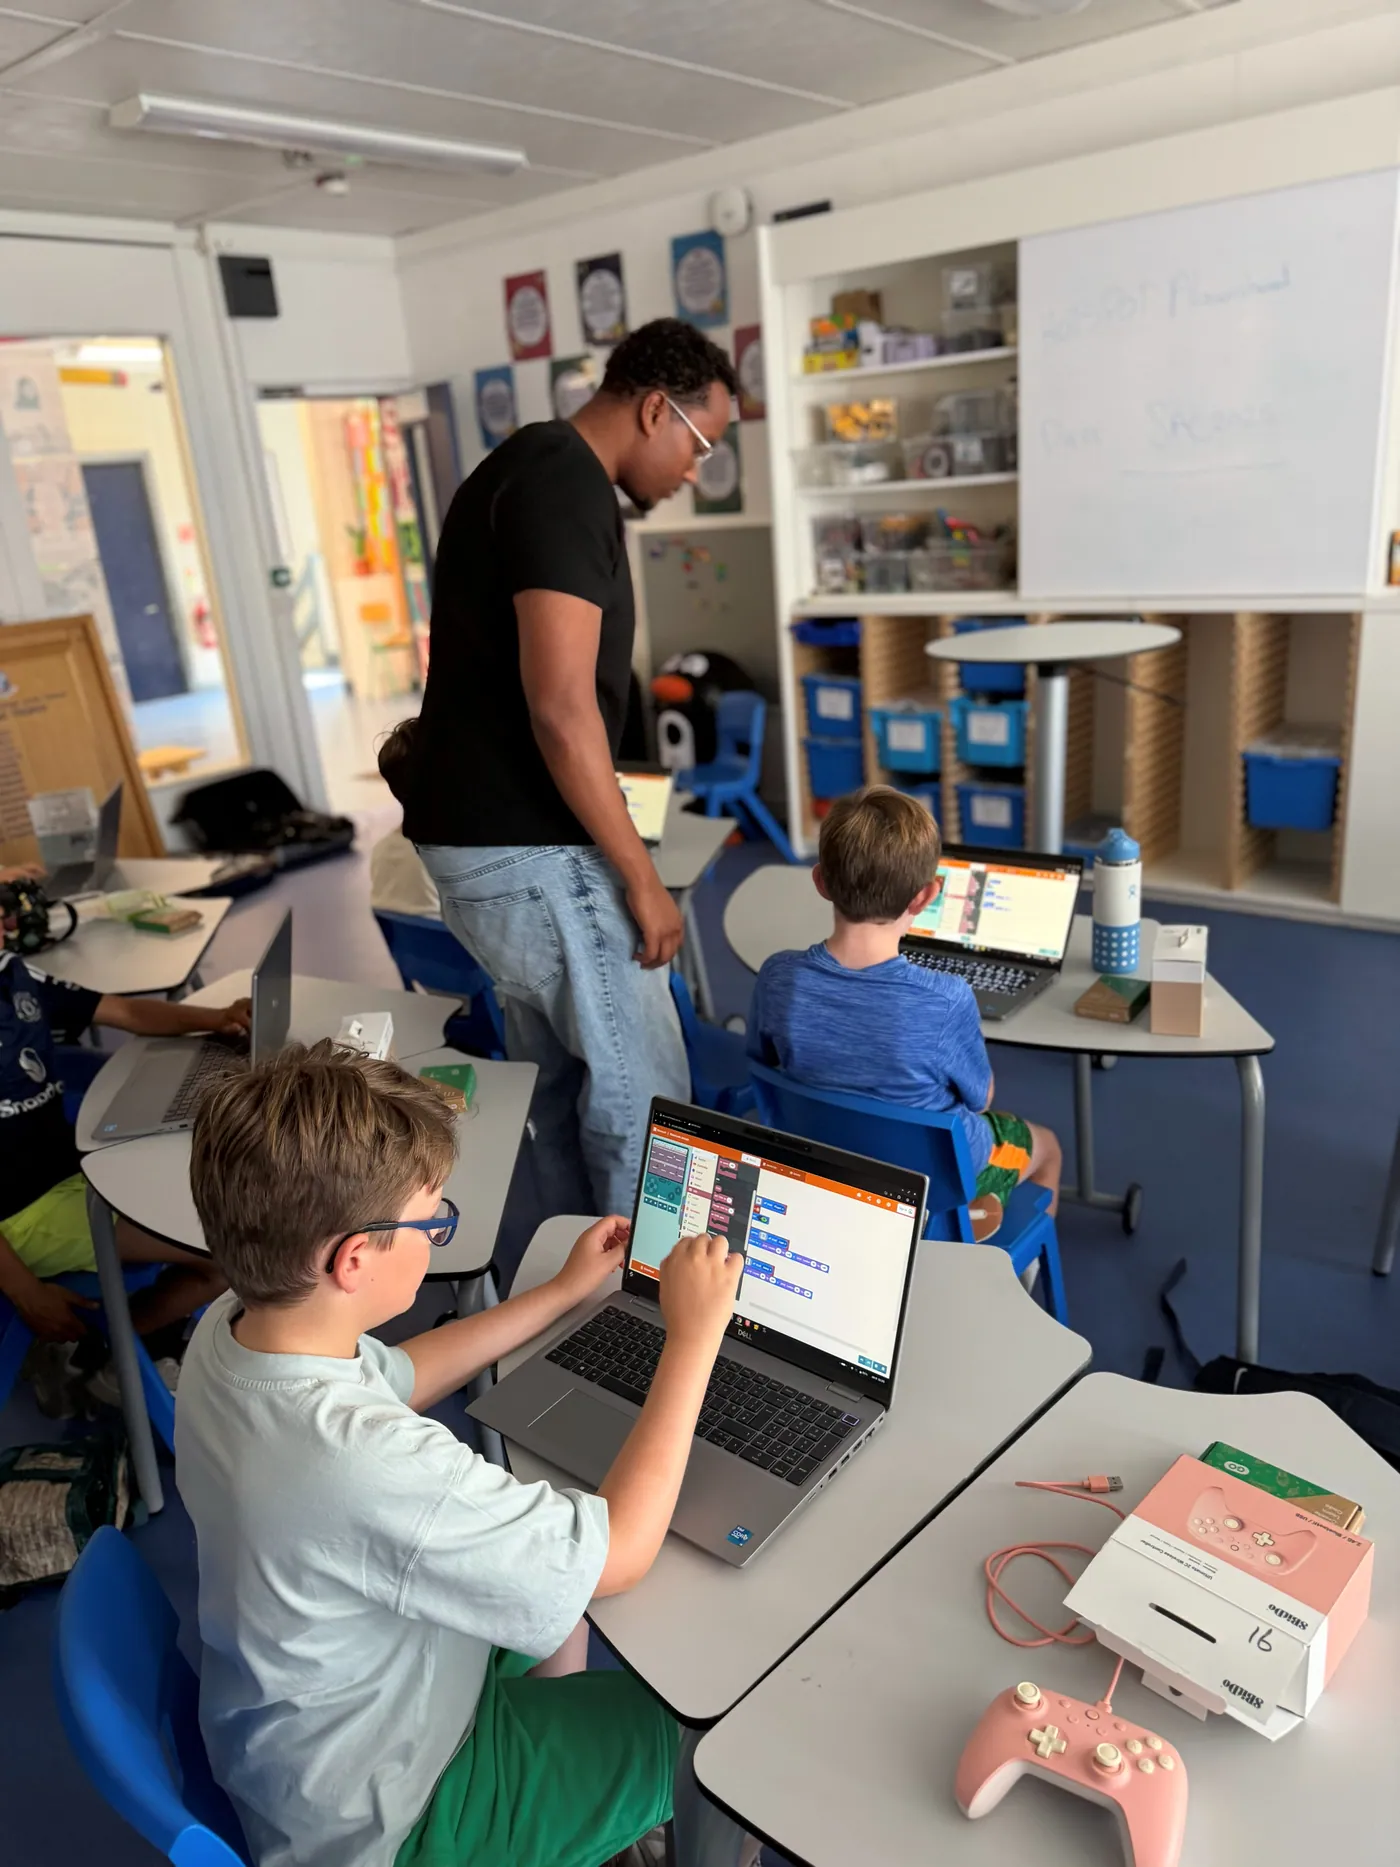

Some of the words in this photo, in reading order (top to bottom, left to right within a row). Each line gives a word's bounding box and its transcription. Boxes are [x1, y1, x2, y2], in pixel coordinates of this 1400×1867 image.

[738, 1329, 752, 1341] DELL
[1229, 1463, 1245, 1473] GO
[1268, 1603, 1309, 1631] 8BitDo
[1222, 1678, 1264, 1709] 8BitDo
